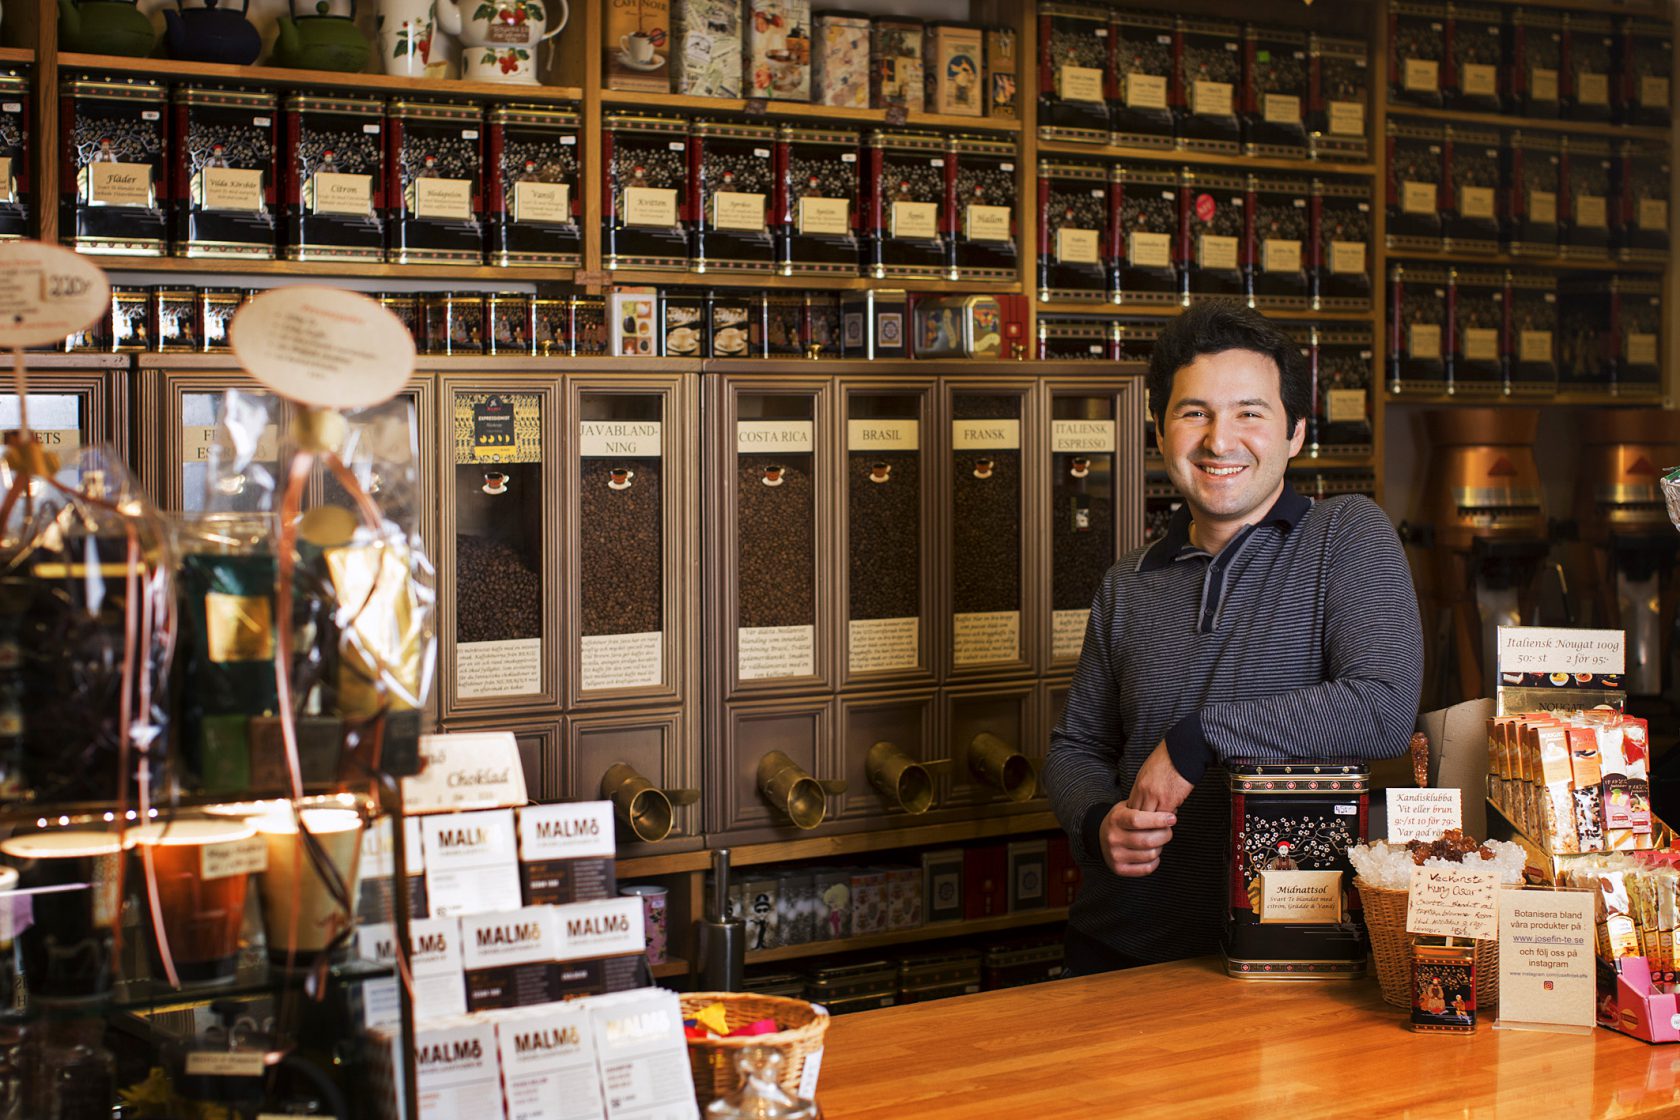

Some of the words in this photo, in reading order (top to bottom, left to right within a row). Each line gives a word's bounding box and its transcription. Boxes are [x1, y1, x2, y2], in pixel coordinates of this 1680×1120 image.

[106, 174, 136, 184] Fläder
[210, 176, 228, 184] Vilda
[230, 177, 256, 186] Körsbär
[330, 185, 358, 194] Citron
[531, 190, 556, 201] Vanilj
[638, 199, 667, 207] Kvitten
[976, 214, 1003, 224] Hallon
[580, 425, 658, 436] JAVABLAND-
[1056, 424, 1107, 434] ITALIENSK
[738, 431, 778, 442] COSTA
[782, 431, 808, 442] RICA
[863, 430, 902, 440] BRASIL
[964, 429, 1006, 440] FRANSK
[606, 442, 636, 453] NING
[1058, 439, 1106, 449] ESPRESSO
[1506, 638, 1551, 648] Italiensk
[1554, 639, 1594, 652] Nougat
[1596, 642, 1619, 652] 100g
[1517, 654, 1536, 664] 50:-
[1538, 654, 1547, 662] st
[1573, 653, 1590, 665] för
[1592, 656, 1609, 664] 95:-
[448, 766, 509, 788] Choklad
[1396, 793, 1452, 802] Kandisklubba
[1397, 804, 1410, 813] Vit
[1413, 805, 1430, 813] eller
[1432, 805, 1452, 813] brun
[1426, 816, 1440, 827] för
[1397, 828, 1413, 837] Var
[1415, 828, 1430, 839] god
[1276, 884, 1328, 894] Midnattsol
[1452, 886, 1477, 896] Oscar
[1514, 910, 1557, 919] Botanisera
[1560, 910, 1582, 919] bland
[1511, 920, 1528, 928] våra
[1530, 921, 1568, 930] produkter
[1571, 923, 1581, 931] på
[1513, 935, 1584, 945] www.josefin-te.se
[1536, 948, 1548, 957] följ
[1567, 949, 1578, 958] på
[1529, 959, 1568, 968] instagram
